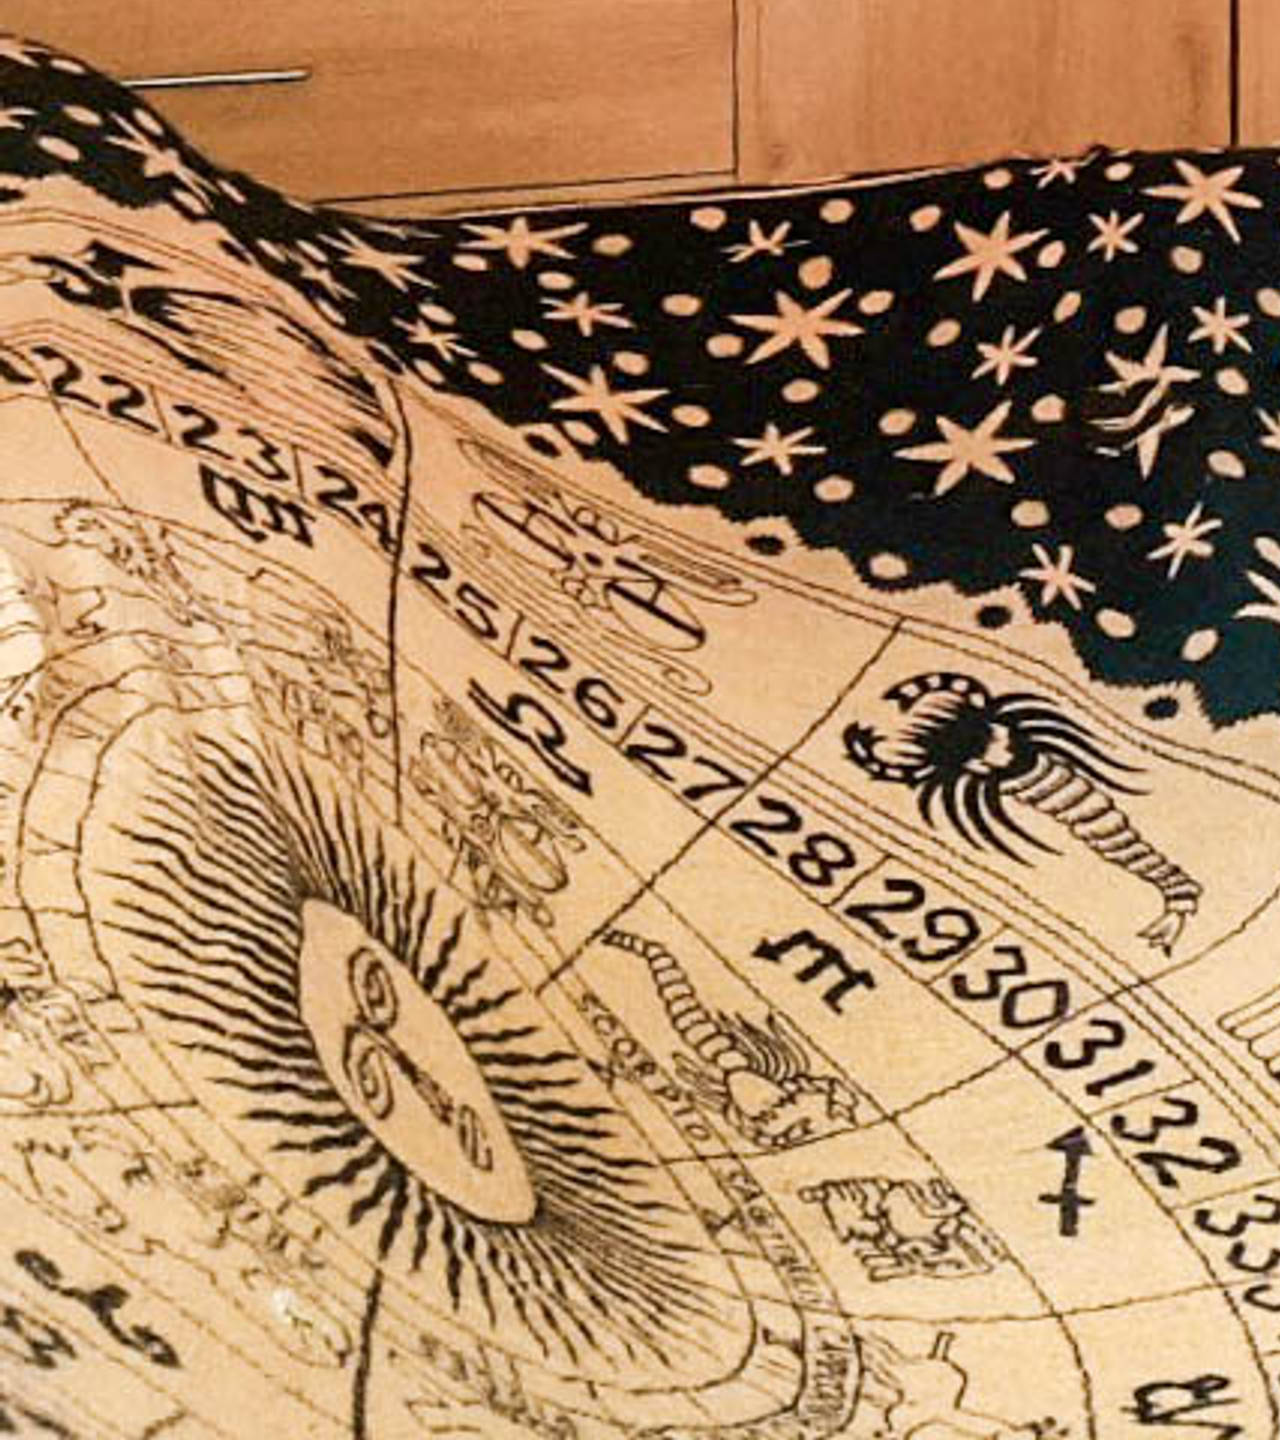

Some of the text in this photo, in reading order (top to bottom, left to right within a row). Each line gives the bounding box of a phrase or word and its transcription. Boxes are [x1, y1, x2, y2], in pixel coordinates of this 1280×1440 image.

[31, 345, 159, 433] 22
[172, 403, 291, 482] 23
[314, 464, 398, 553] 24
[410, 541, 499, 642] 25
[518, 635, 625, 731] 26
[622, 722, 748, 802] 27
[728, 795, 857, 888] 28
[843, 877, 982, 964] 29
[950, 945, 1070, 1030] 30
[1043, 1018, 1157, 1098] 31
[1109, 1096, 1243, 1189] 32
[578, 990, 711, 1144] SCORPIO
